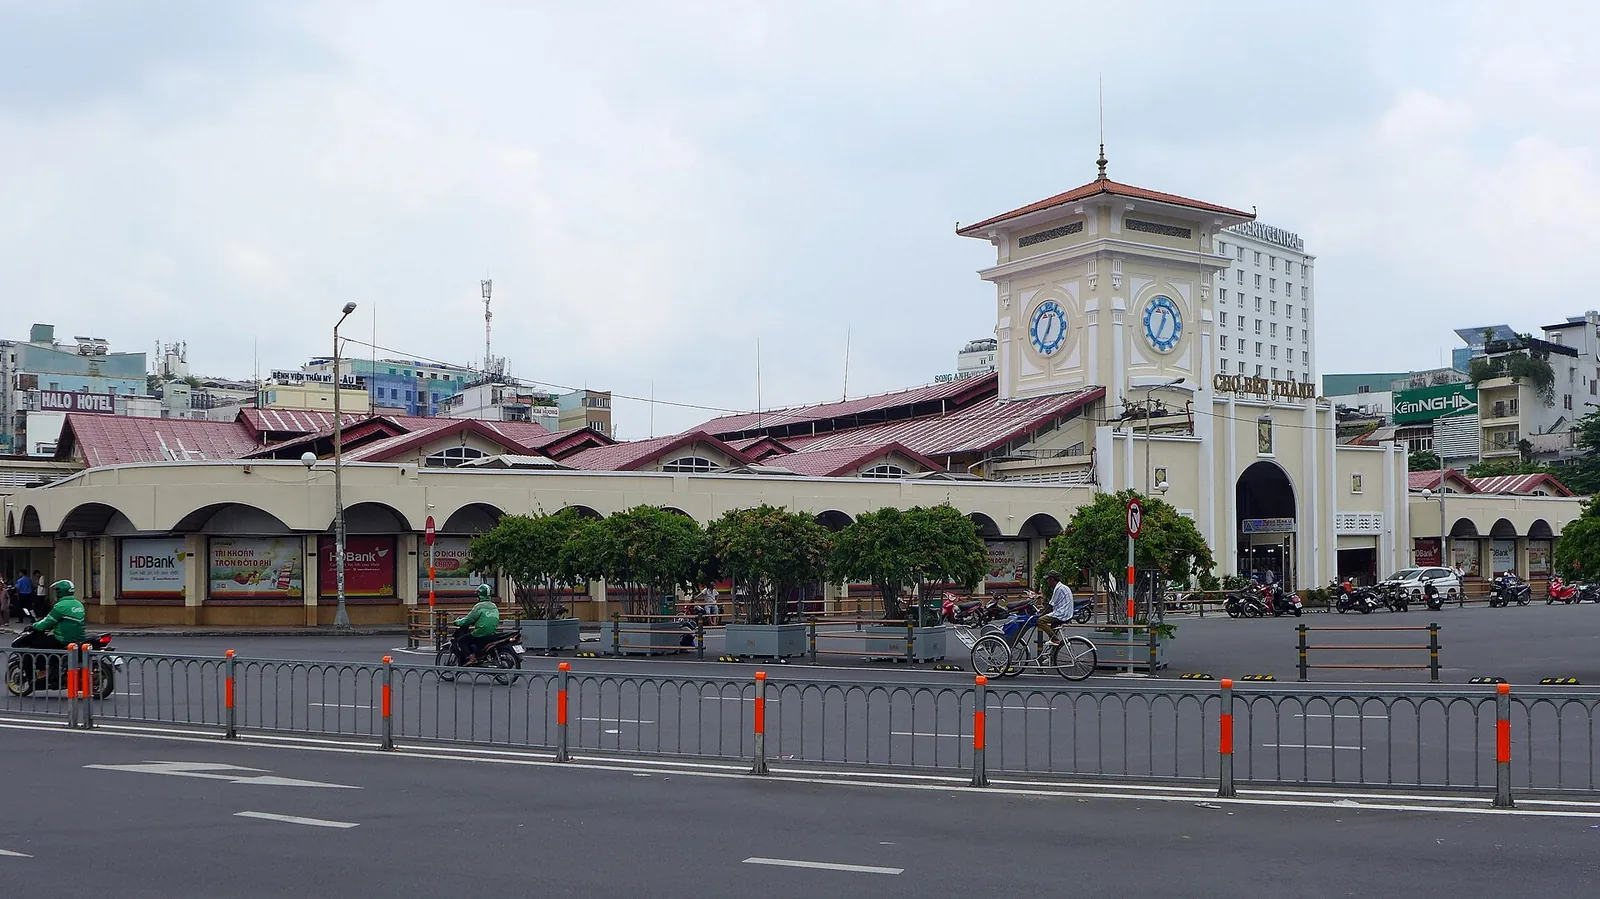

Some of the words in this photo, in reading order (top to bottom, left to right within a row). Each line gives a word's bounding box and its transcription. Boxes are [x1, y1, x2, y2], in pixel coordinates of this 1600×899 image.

[934, 373, 953, 383] SONG
[953, 371, 969, 381] ANH
[1213, 373, 1241, 394] CHỢ
[1244, 374, 1269, 395] BẾN
[1271, 378, 1316, 398] THÀNH
[42, 392, 72, 409] HALO
[77, 394, 113, 411] HOTEL
[130, 555, 175, 568] HDBank
[259, 558, 272, 566] PHÍ
